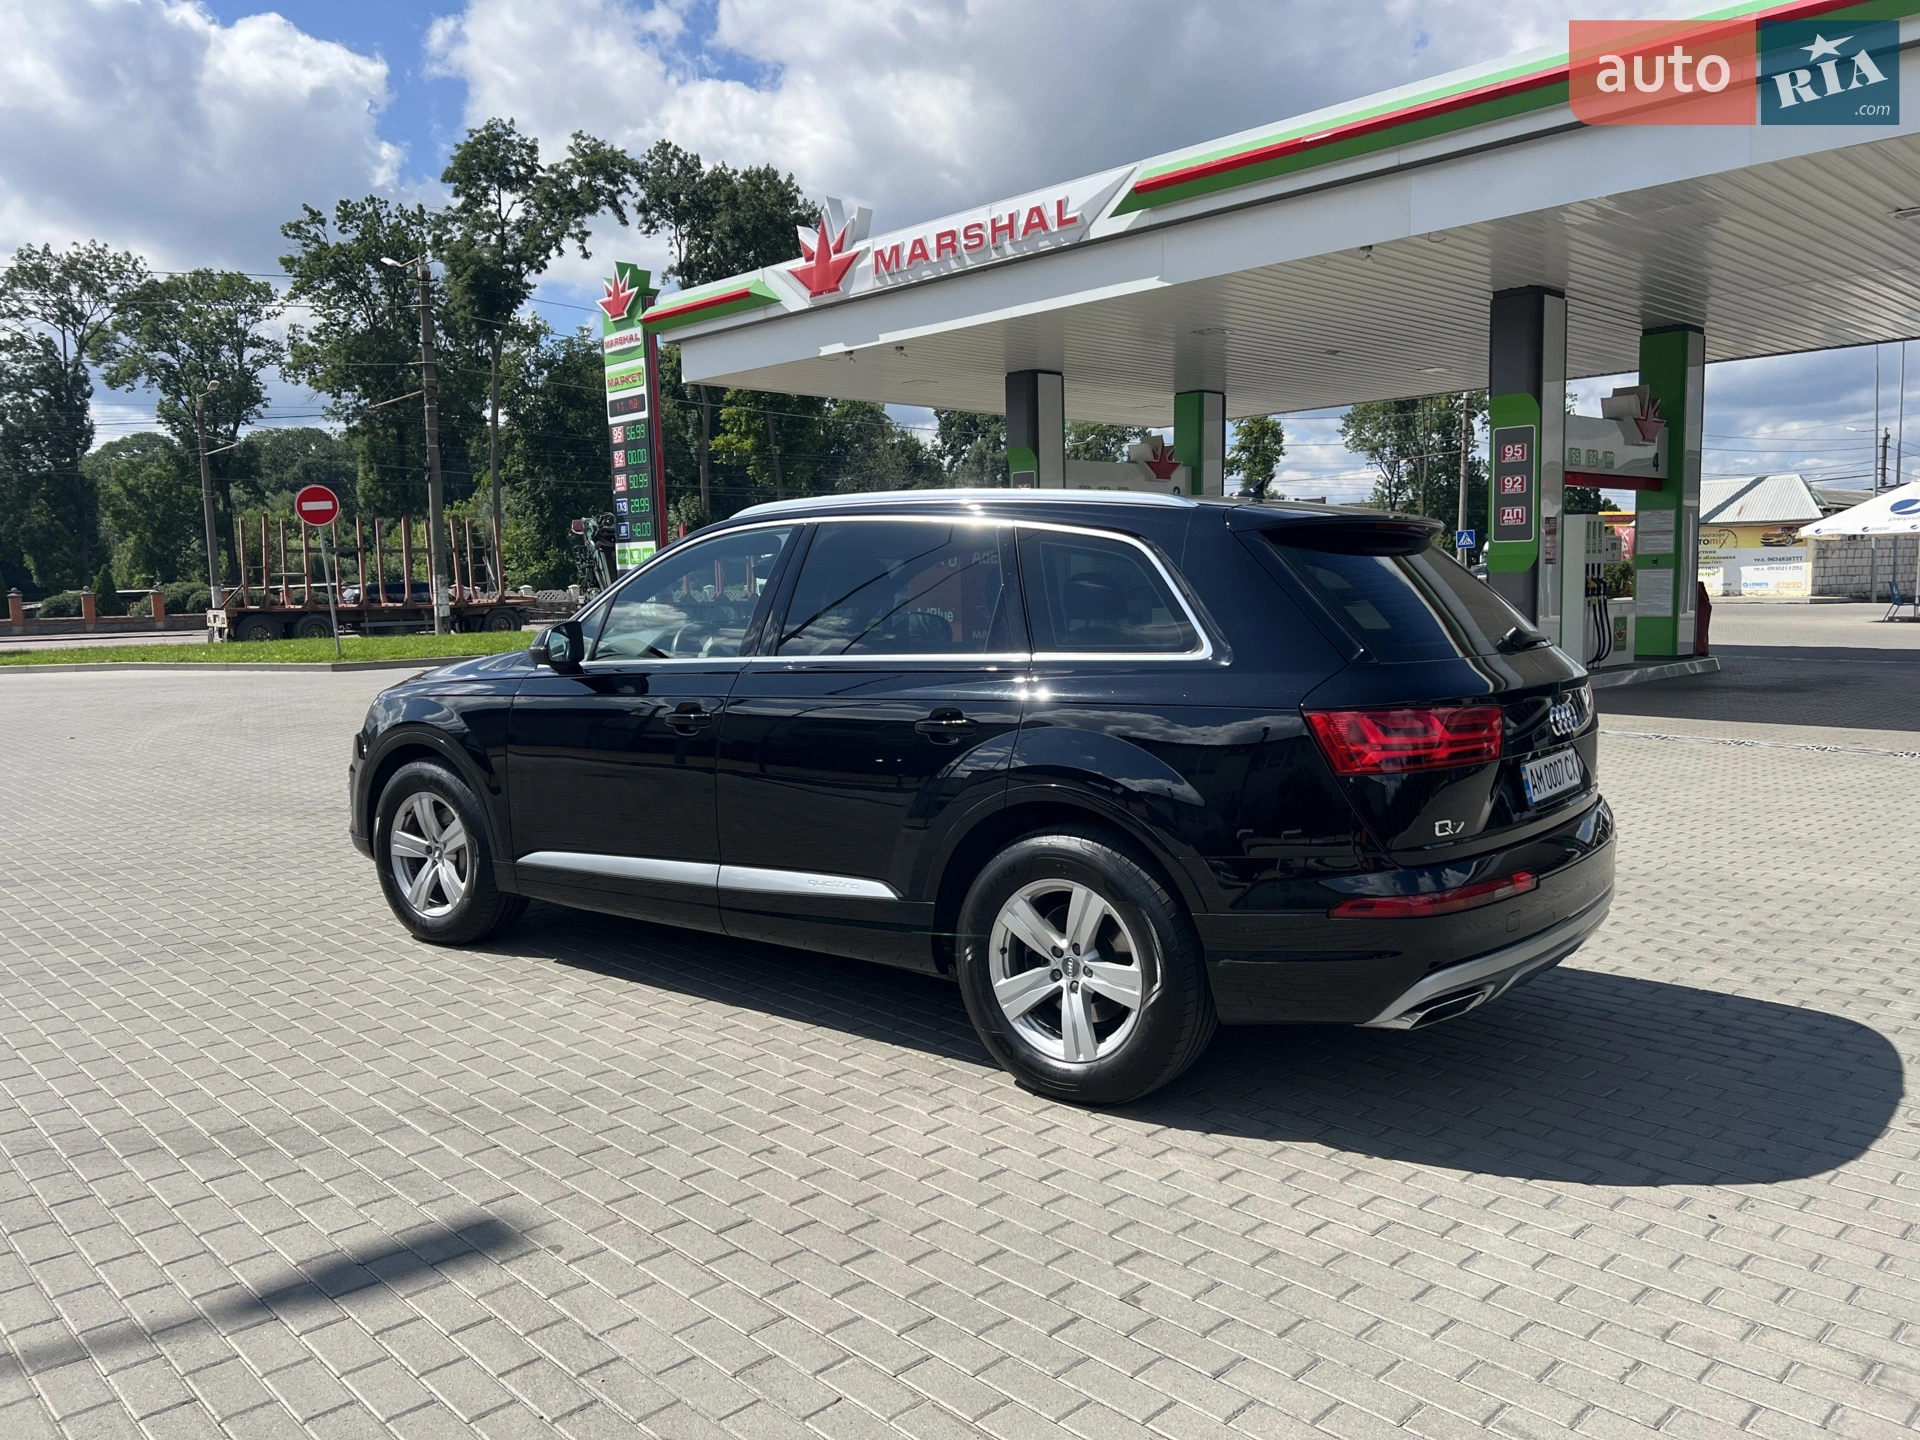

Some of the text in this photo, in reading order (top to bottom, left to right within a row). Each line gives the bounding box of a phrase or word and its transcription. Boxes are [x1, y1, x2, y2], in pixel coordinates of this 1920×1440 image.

[874, 198, 1081, 276] MARSHAL
[604, 333, 641, 350] MARSHAL
[612, 424, 646, 441] 95 56.99
[614, 449, 647, 465] 92 00.00
[1504, 444, 1523, 457] 95
[1652, 452, 1660, 472] 4
[629, 473, 649, 489] 50.99
[1504, 476, 1522, 489] 92
[617, 497, 650, 513] ГАЗ 29.99
[1503, 508, 1522, 520] ДП
[1529, 765, 1547, 797] AM
[1543, 758, 1565, 790] 0007
[807, 879, 859, 890] quattro
